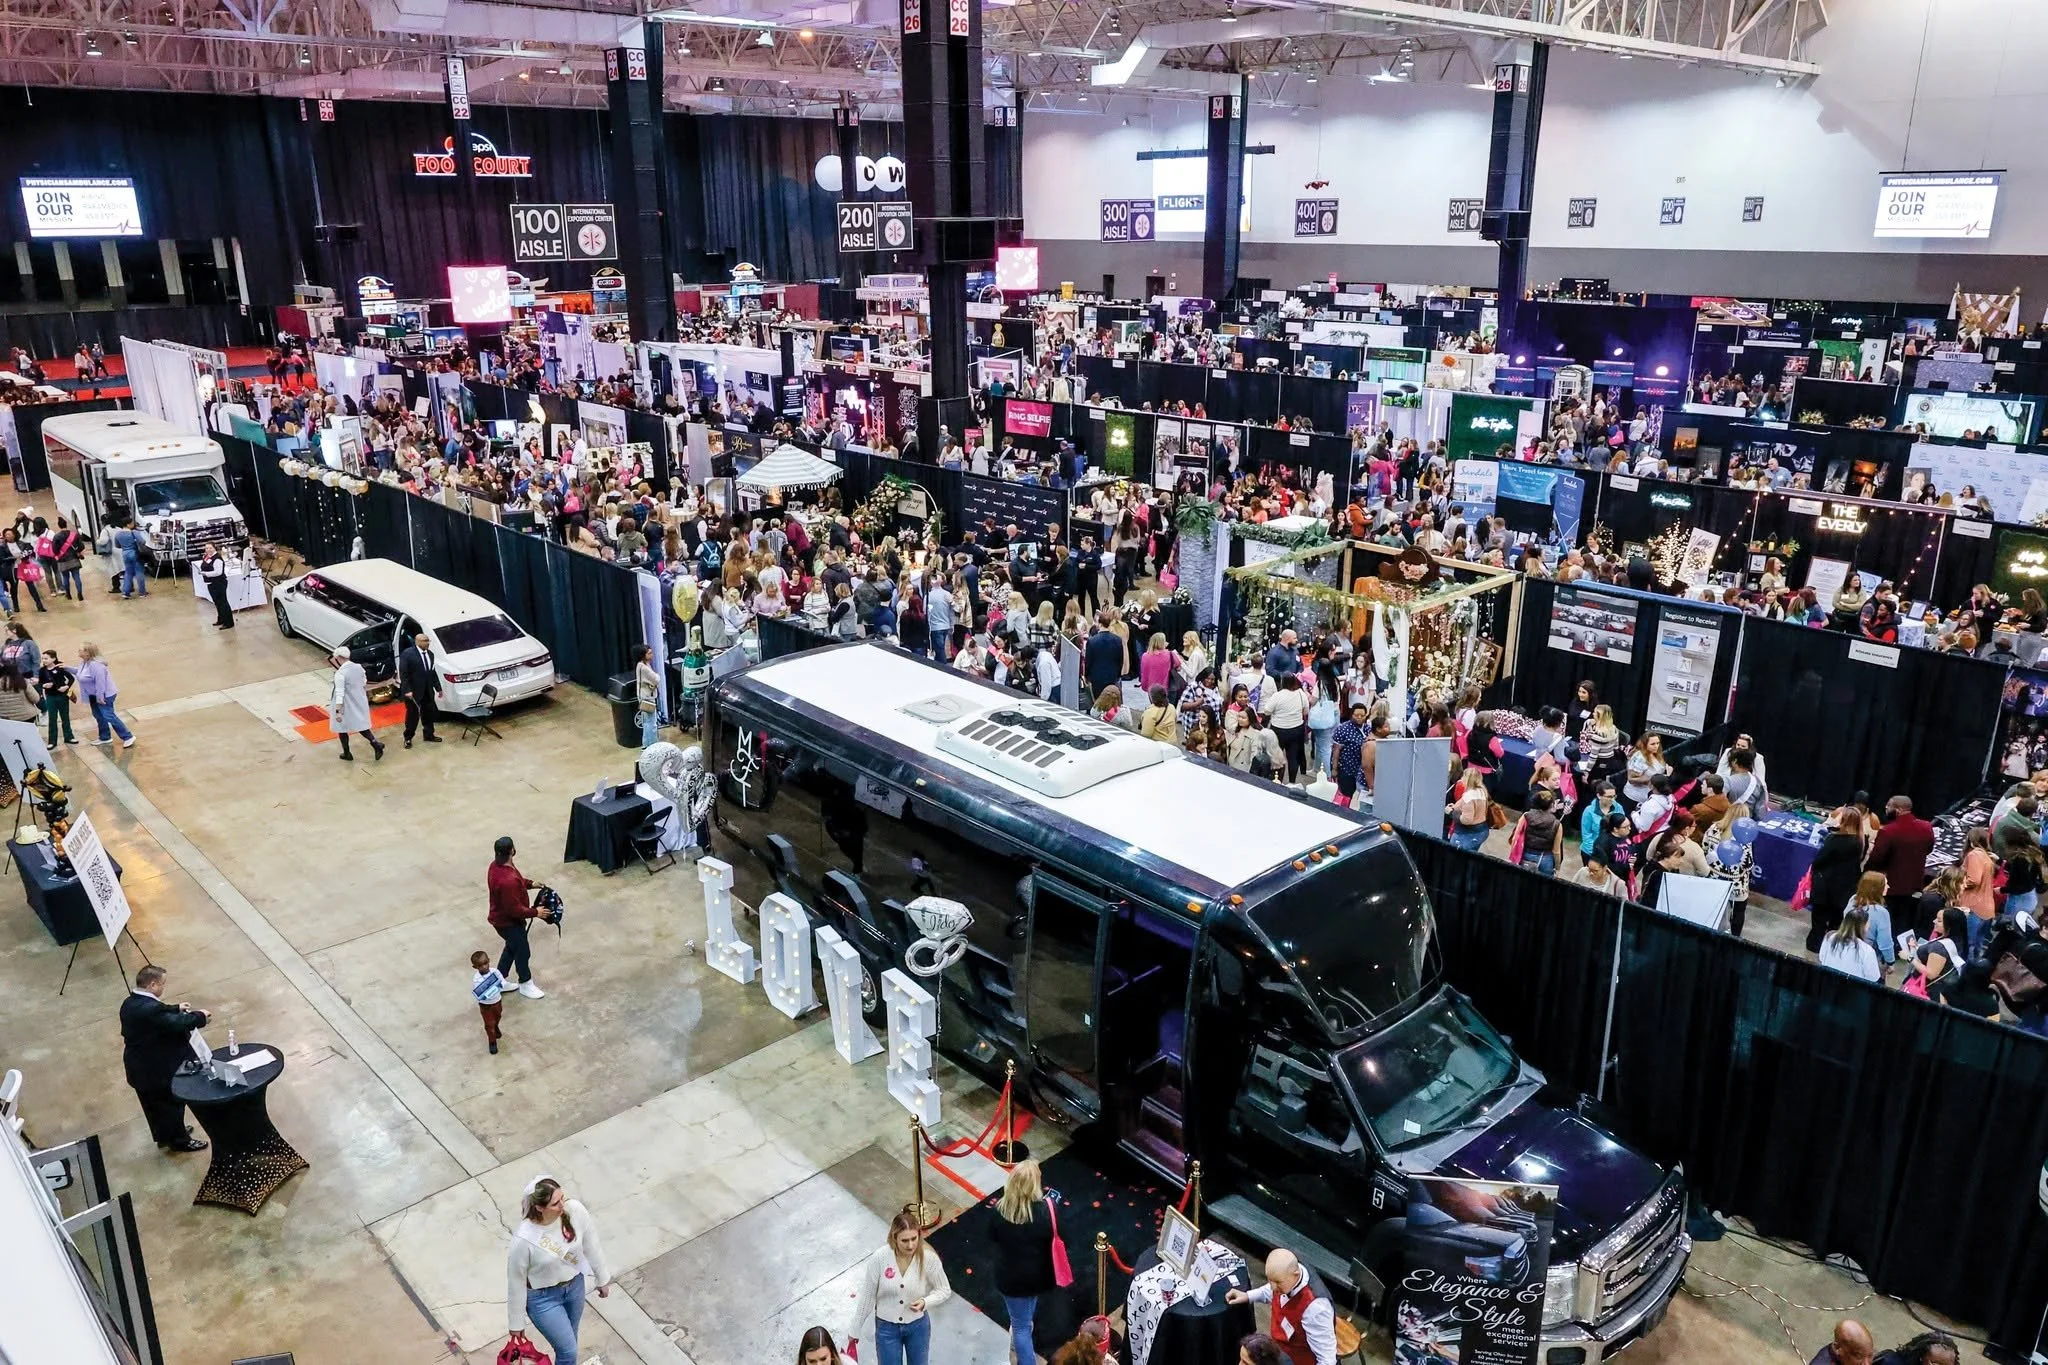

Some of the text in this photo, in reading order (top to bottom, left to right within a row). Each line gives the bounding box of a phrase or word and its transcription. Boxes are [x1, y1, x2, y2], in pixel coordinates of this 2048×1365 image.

[951, 0, 968, 12] CC
[905, 15, 920, 30] 26
[952, 18, 968, 32] 26
[607, 52, 617, 63] CC
[628, 52, 644, 62] CC
[609, 67, 618, 78] 24
[630, 66, 645, 77] 24
[1502, 68, 1509, 77] Y
[1497, 80, 1511, 90] 26
[319, 101, 332, 109] CC
[321, 111, 334, 119] 20
[454, 108, 469, 117] 22
[1213, 108, 1223, 116] 24
[1232, 108, 1240, 116] 24
[416, 156, 530, 174] FOO COURT
[36, 192, 71, 203] JOIN
[1163, 197, 1199, 208] FLIGHT
[1890, 192, 1926, 203] JOIN
[37, 204, 73, 216] OUR
[1298, 202, 1316, 218] 400
[1450, 202, 1465, 216] 500
[1570, 200, 1583, 214] 600
[1663, 200, 1674, 211] 700
[1888, 204, 1925, 216] OUR
[840, 207, 873, 228] 200
[1103, 204, 1127, 222] 300
[514, 209, 561, 234] 100
[1297, 220, 1315, 233] AISLE
[1450, 218, 1464, 229] AISLE
[1568, 216, 1582, 226] AISLE
[1104, 226, 1127, 239] AISLE
[842, 233, 874, 247] AISLE
[519, 240, 563, 256] AISLE
[1008, 411, 1051, 424] RING SELFIE
[1518, 466, 1536, 475] Travel
[1831, 503, 1859, 519] THE
[1817, 517, 1868, 534] EVERLY
[1664, 611, 1687, 621] Register
[1695, 617, 1718, 626] Receive
[1651, 725, 1672, 734] Culinary
[697, 856, 941, 1127] LOVE
[1456, 1274, 1488, 1285] Where
[1402, 1268, 1545, 1304] Elegance &
[1450, 1298, 1526, 1330] Style
[1486, 1331, 1537, 1341] exceptional
[1493, 1338, 1528, 1347] services
